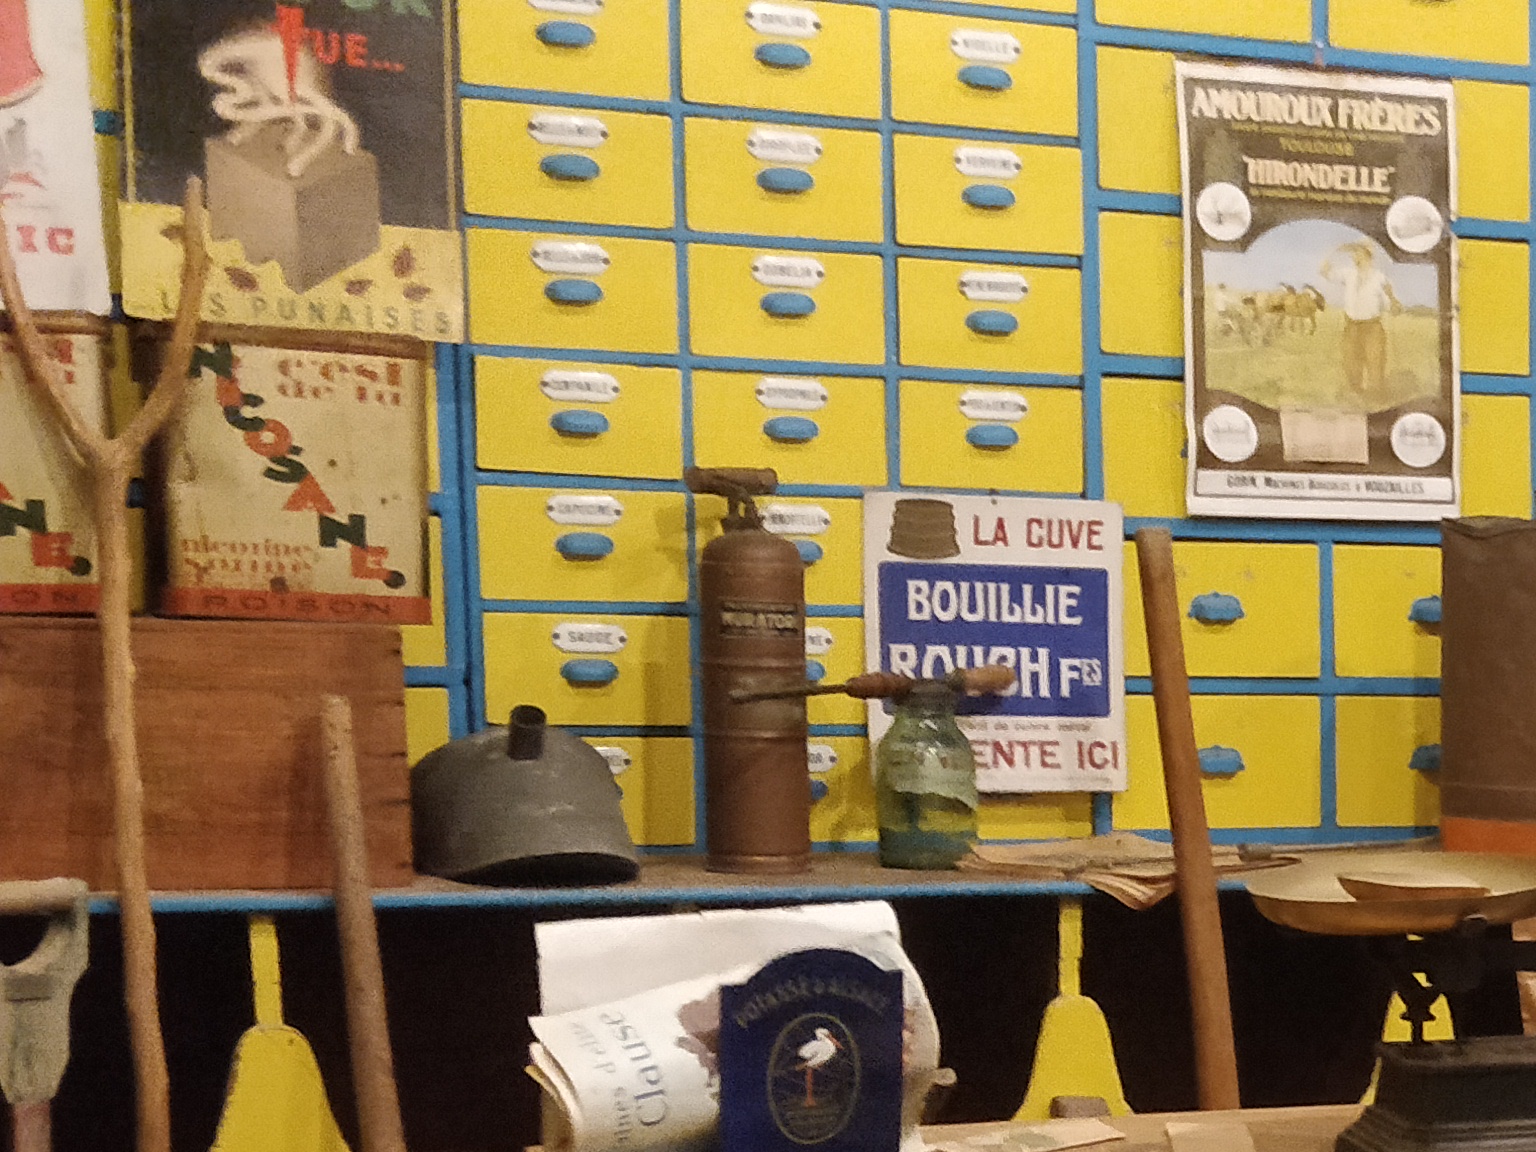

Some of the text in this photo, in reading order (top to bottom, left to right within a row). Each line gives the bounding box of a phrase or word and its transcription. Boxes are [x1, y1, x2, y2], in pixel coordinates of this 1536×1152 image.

[1192, 88, 1337, 128] AMOUROUX
[250, 296, 451, 336] PUNAISES
[973, 514, 1105, 551] LA CUVE
[906, 579, 1083, 627] BOUILLIE
[968, 738, 1120, 771] ENTE ICI
[599, 1008, 668, 1129] Clause
